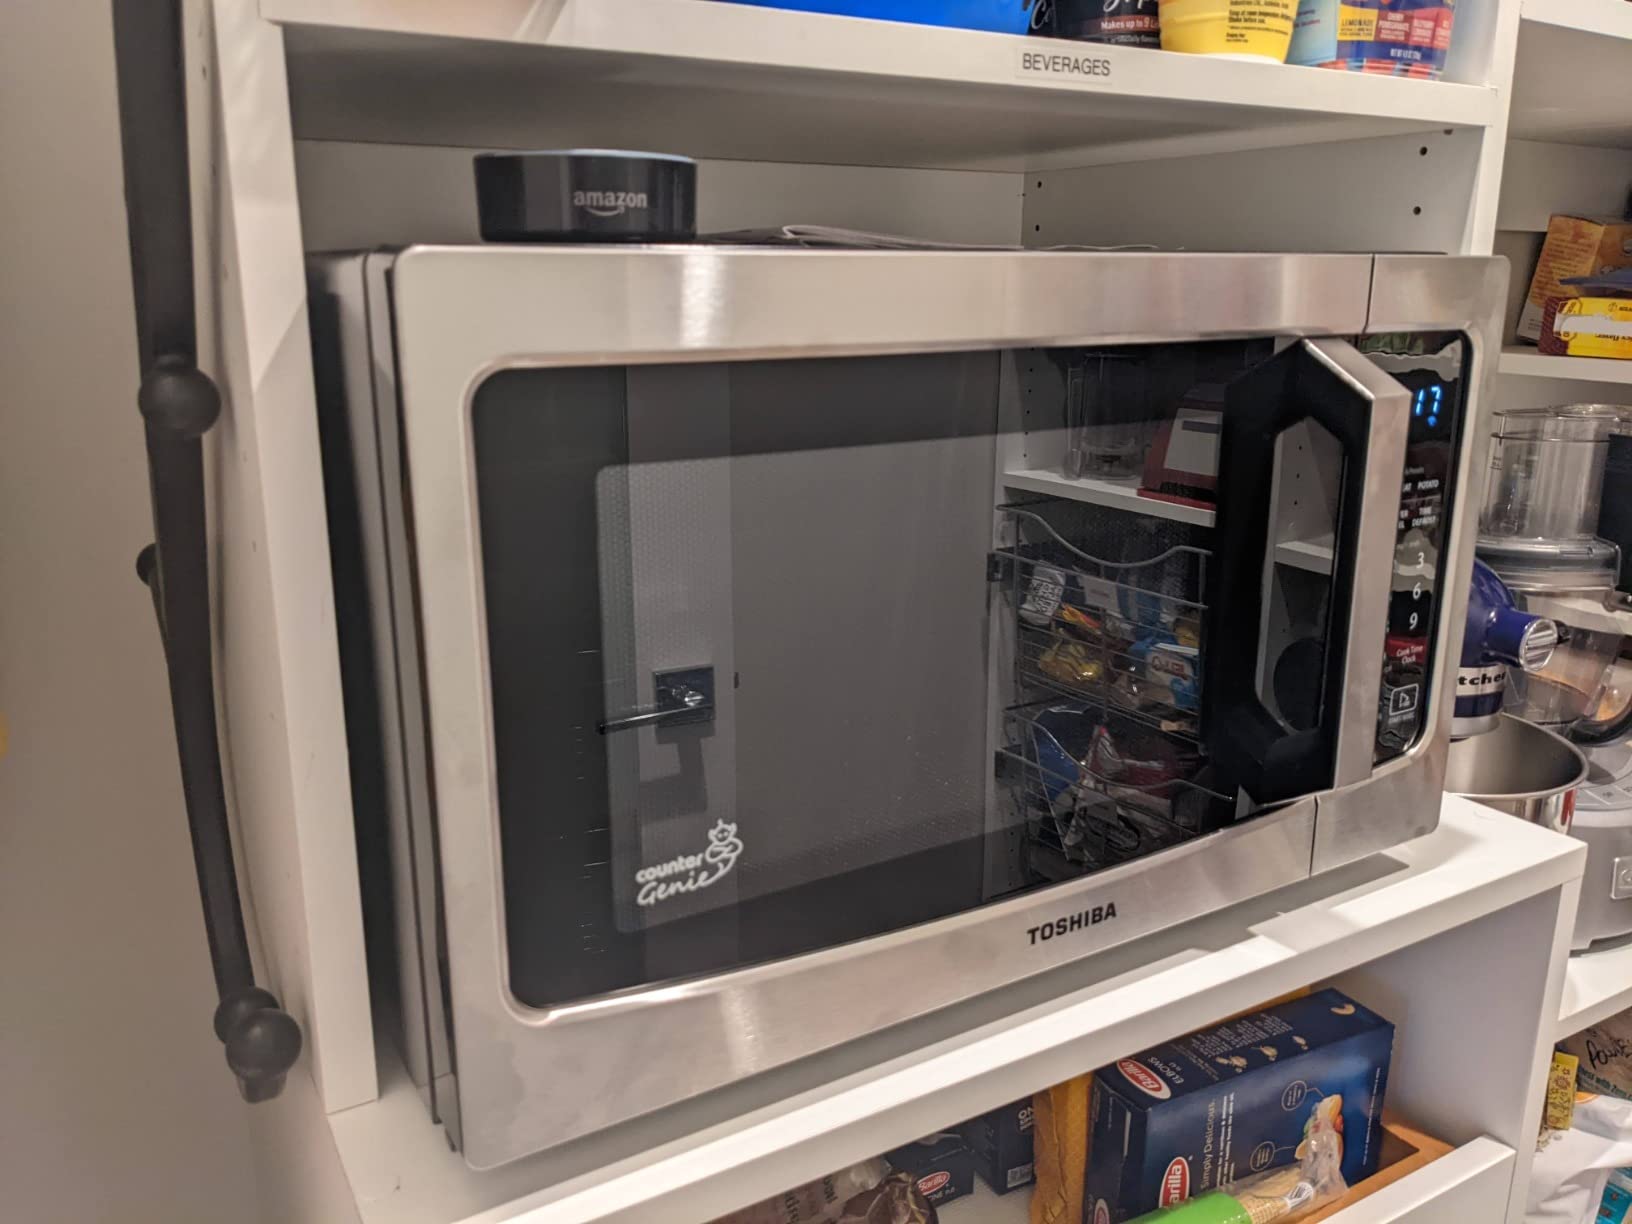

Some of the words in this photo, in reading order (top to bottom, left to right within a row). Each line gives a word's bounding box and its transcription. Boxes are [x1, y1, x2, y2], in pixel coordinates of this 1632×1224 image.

[1101, 19, 1124, 30] Makes
[1125, 20, 1135, 29] up
[1136, 18, 1143, 28] to
[1341, 17, 1374, 27] LEMONADE
[1022, 53, 1111, 76] BEVERAGES
[573, 190, 648, 210] amazon
[1418, 479, 1439, 490] POTATO
[1412, 515, 1437, 527] DEFROST
[1416, 552, 1425, 569] 3
[1412, 582, 1421, 600] 6
[1409, 612, 1418, 630] 9
[1396, 648, 1410, 658] Cook
[1410, 645, 1424, 654] Time
[1401, 655, 1416, 665] Clock
[635, 852, 703, 884] counter
[637, 868, 720, 906] Genie
[1026, 901, 1117, 945] TOSHIBA
[1120, 1060, 1162, 1092] Barilla
[1148, 1056, 1185, 1085] ELBOWS
[1201, 1154, 1212, 1189] Simply
[919, 1173, 947, 1192] Barilla
[1168, 1164, 1182, 1204] arilla
